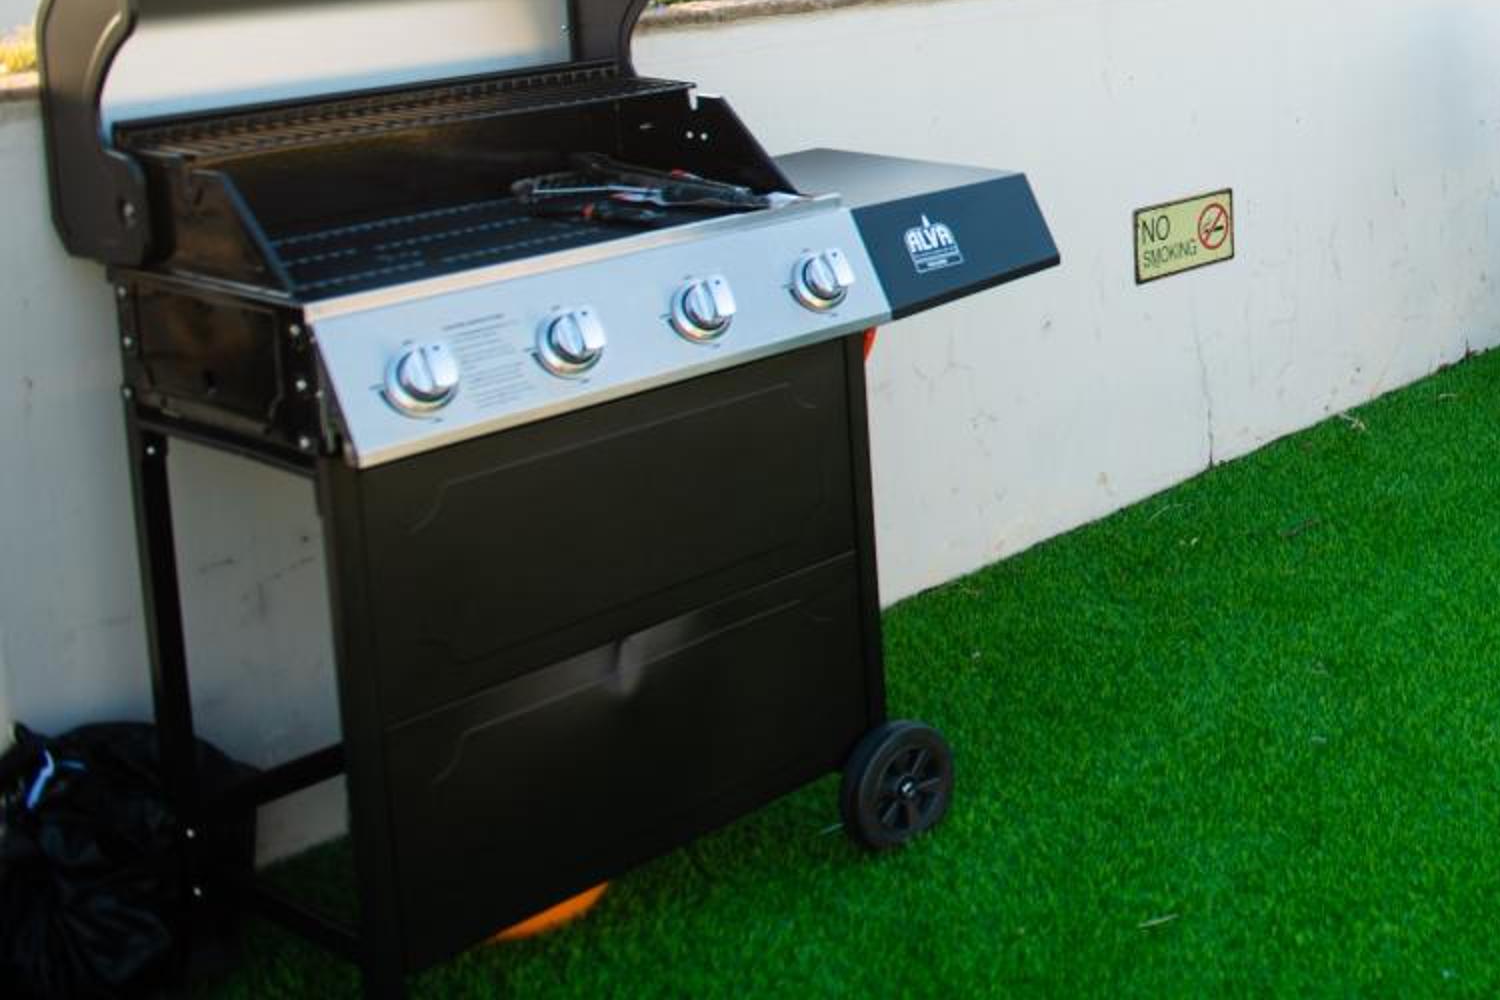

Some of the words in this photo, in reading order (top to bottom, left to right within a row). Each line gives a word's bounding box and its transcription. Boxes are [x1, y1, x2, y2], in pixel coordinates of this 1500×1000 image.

[905, 223, 954, 253] ALVA
[1141, 215, 1171, 245] NO
[1143, 238, 1198, 269] SMOKING
